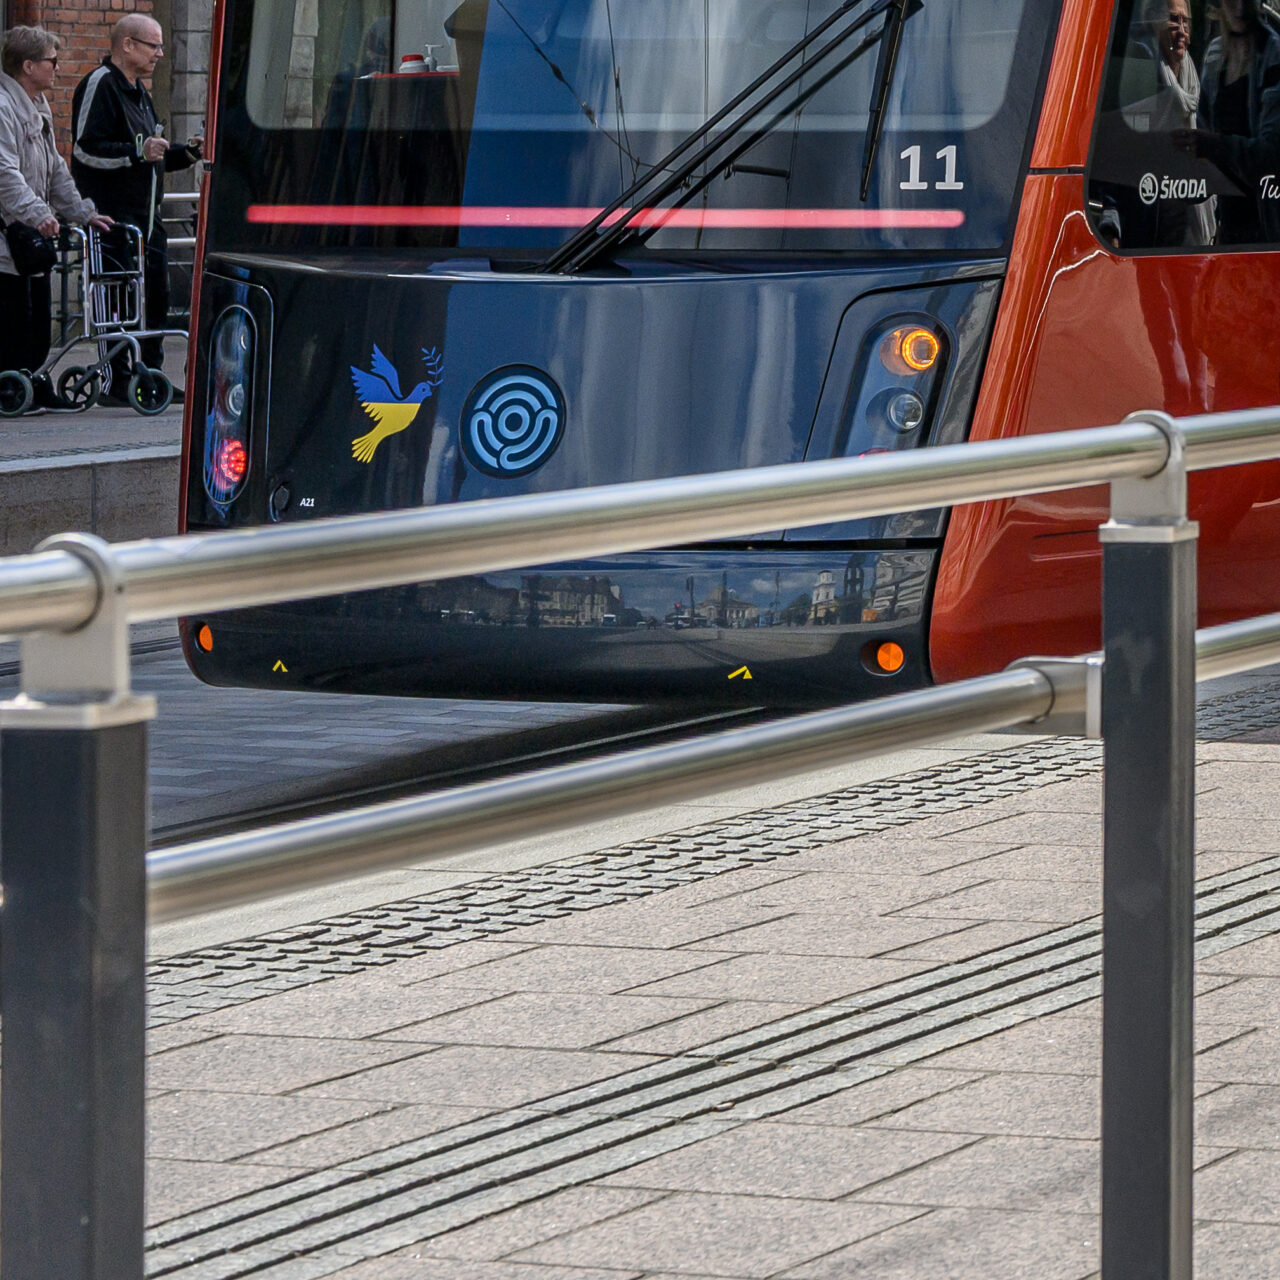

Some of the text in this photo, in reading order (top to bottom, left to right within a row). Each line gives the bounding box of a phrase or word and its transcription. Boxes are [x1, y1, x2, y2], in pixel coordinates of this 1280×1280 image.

[899, 145, 964, 190] 11
[1160, 175, 1208, 199] ŠKODA
[299, 497, 315, 507] A21
